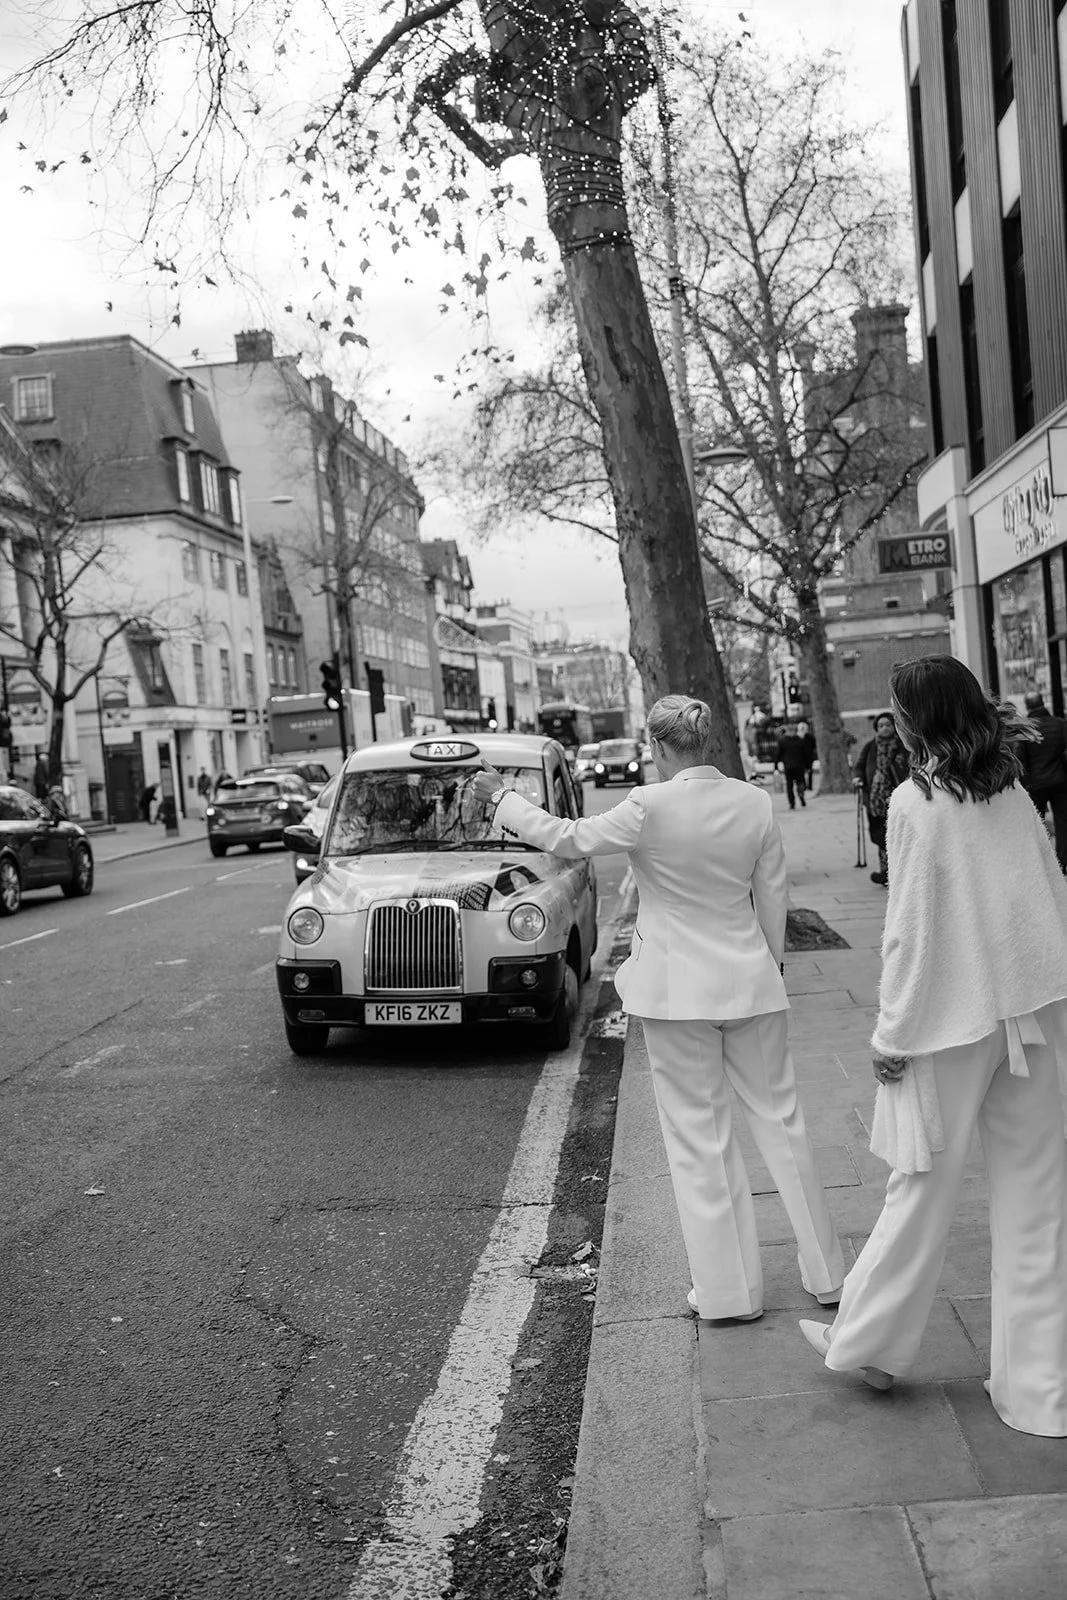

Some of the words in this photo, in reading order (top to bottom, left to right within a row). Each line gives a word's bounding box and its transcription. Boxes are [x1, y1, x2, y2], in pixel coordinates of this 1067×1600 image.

[911, 552, 946, 566] BANK
[289, 718, 333, 730] WAITROSE
[424, 744, 463, 756] TAXI
[375, 1005, 412, 1021] KF16
[417, 1004, 450, 1021] ZKZ
